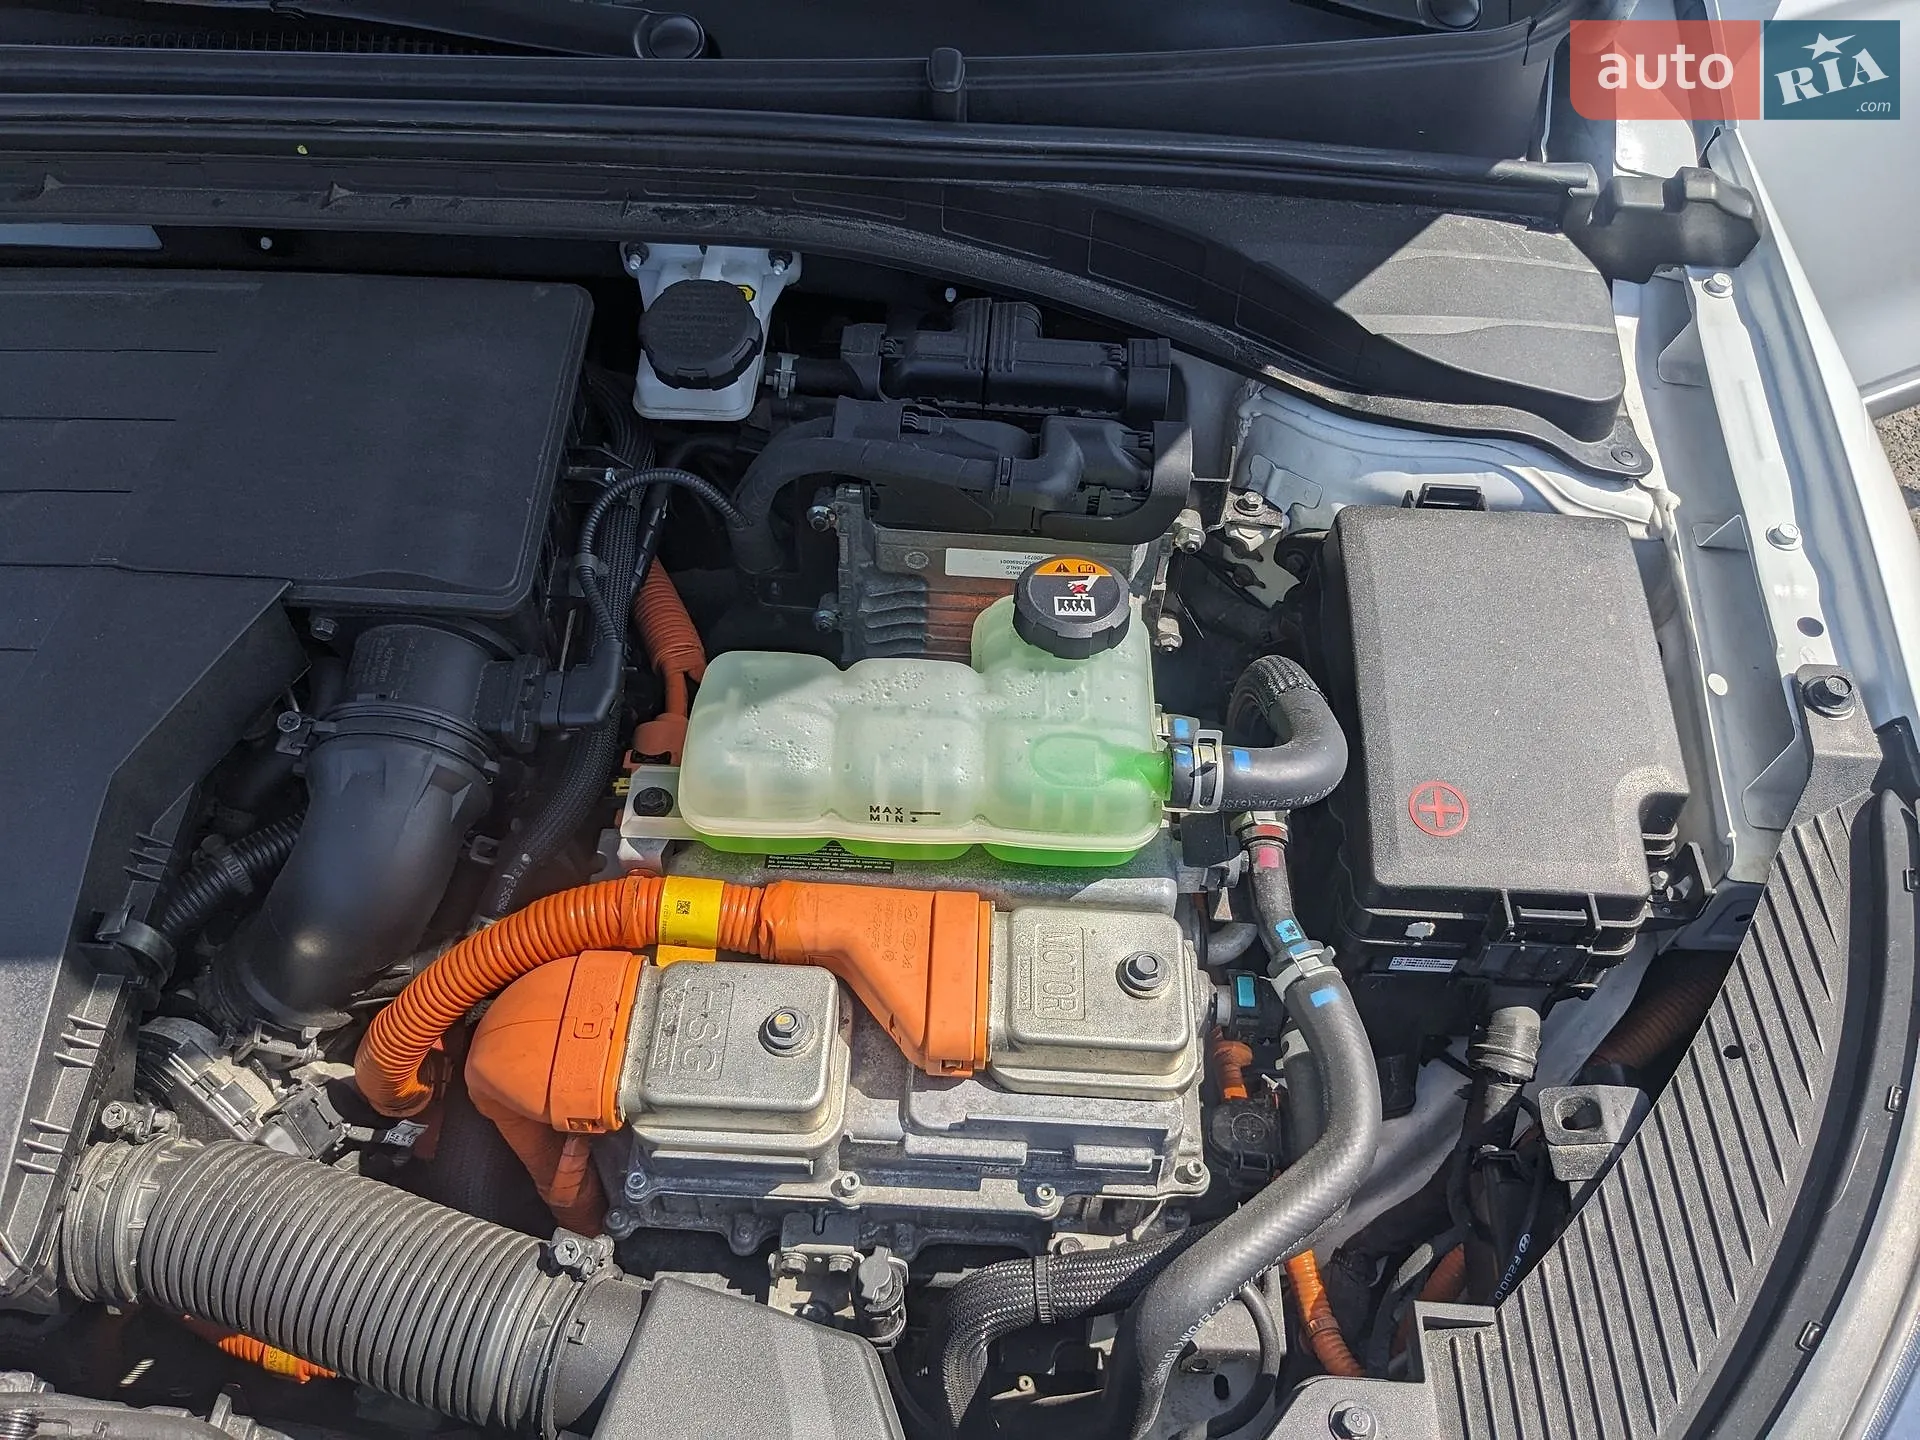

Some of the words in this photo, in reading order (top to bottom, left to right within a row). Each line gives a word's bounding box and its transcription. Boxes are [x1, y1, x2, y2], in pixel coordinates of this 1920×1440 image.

[869, 805, 904, 815] MAX
[869, 814, 904, 823] MIN
[1043, 931, 1078, 1011] MOTOR
[680, 982, 730, 1072] HSG
